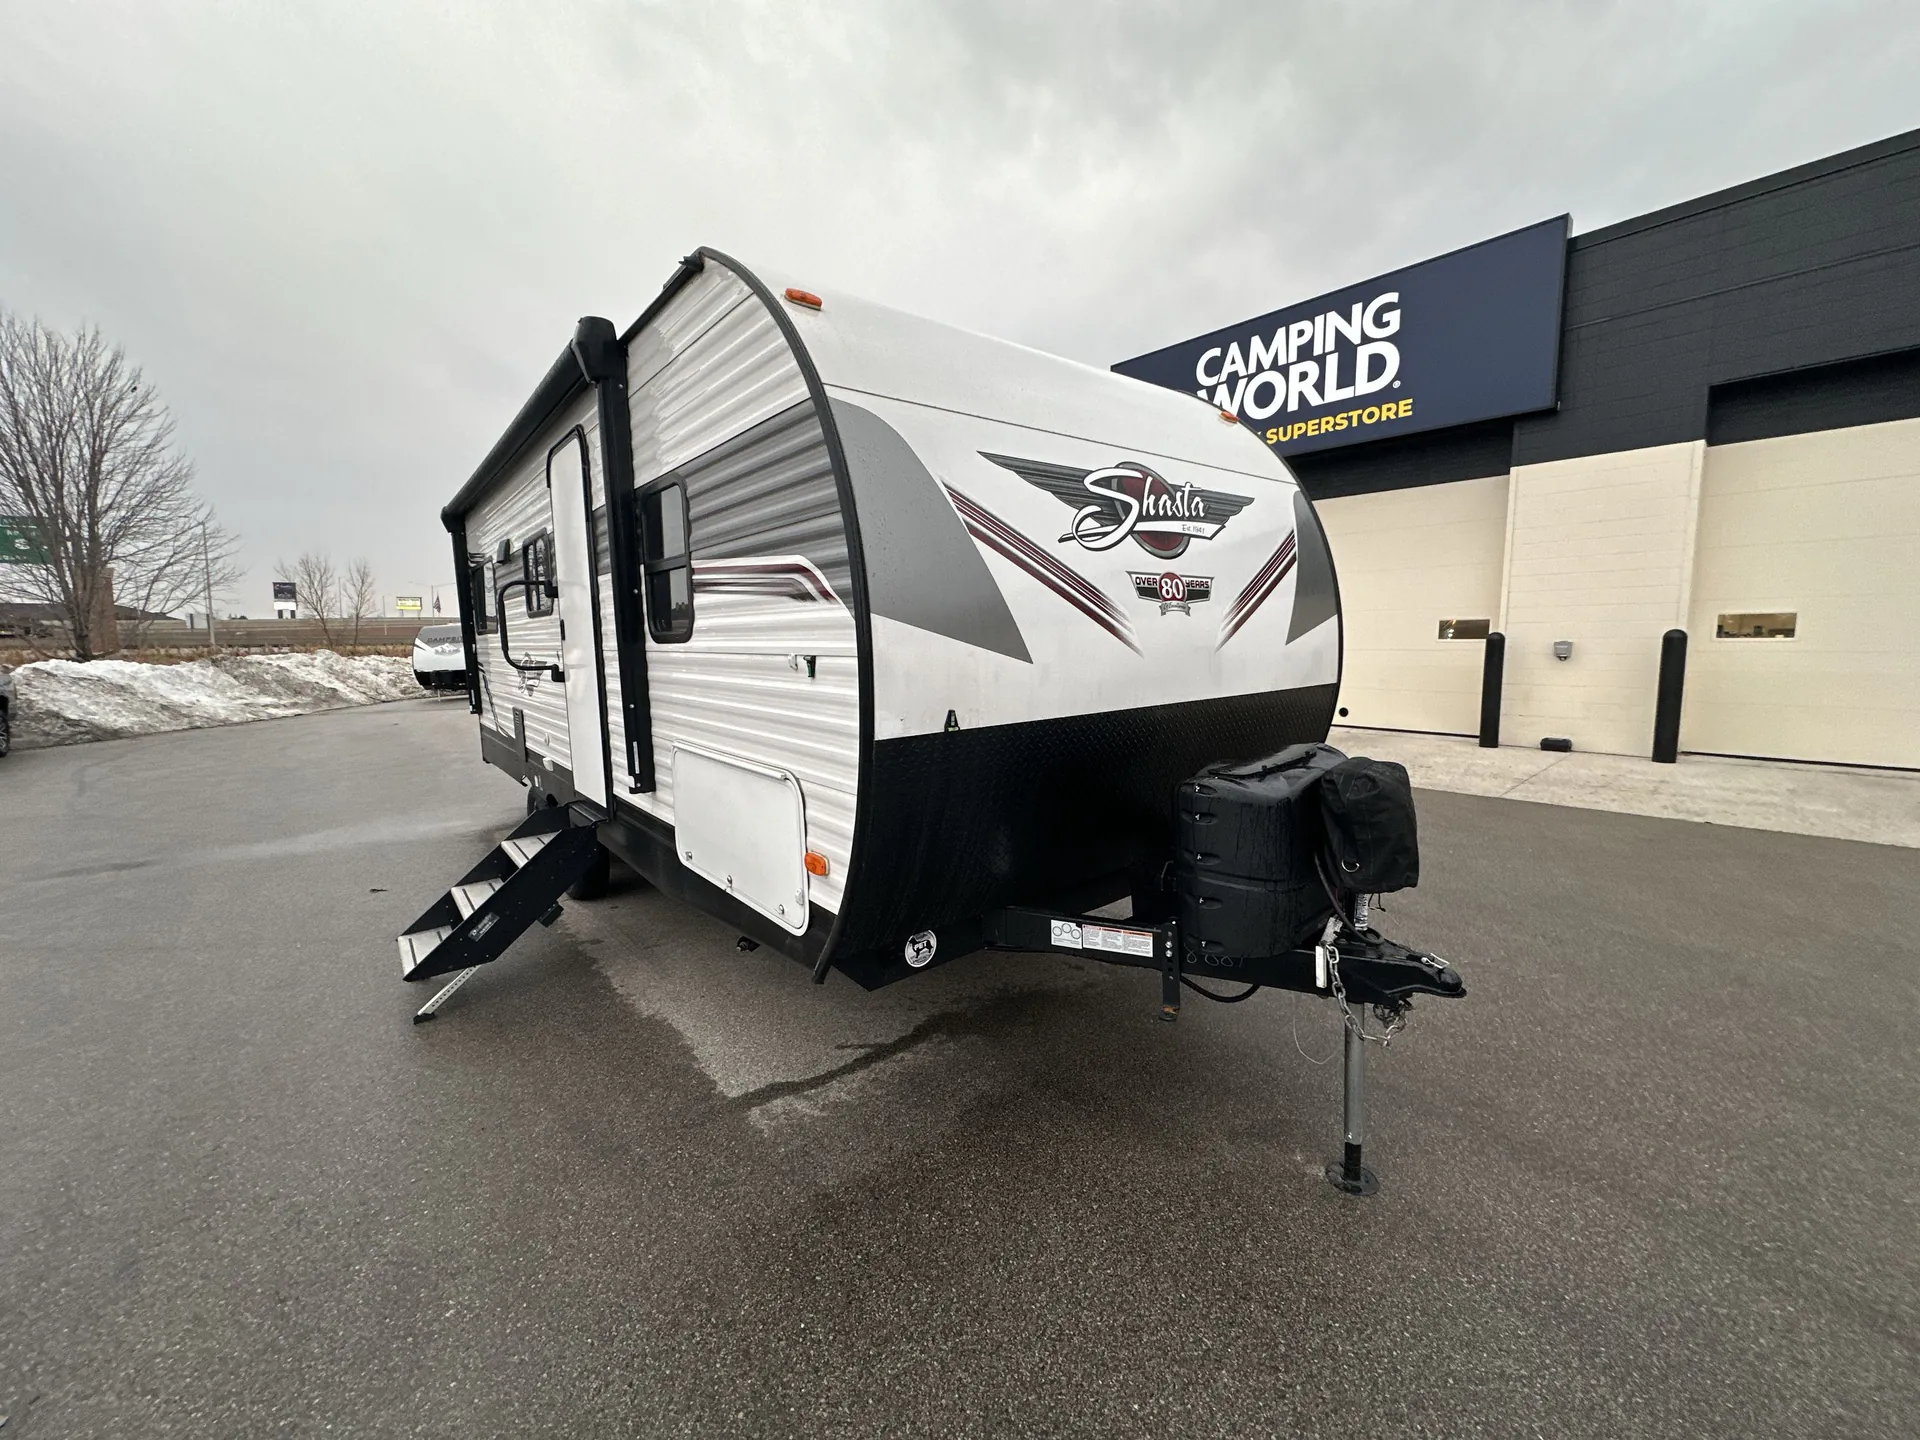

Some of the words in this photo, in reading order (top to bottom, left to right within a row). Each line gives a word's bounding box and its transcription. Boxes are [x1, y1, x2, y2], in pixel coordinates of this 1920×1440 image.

[1196, 292, 1401, 387] CAMPING
[1196, 341, 1400, 420] WORLD
[1266, 398, 1413, 445] SUPERSTORE
[1072, 467, 1208, 549] Shasta
[1135, 576, 1157, 586] OVER
[1161, 578, 1183, 599] 80
[1185, 580, 1209, 589] YEARS
[914, 940, 927, 951] PET
